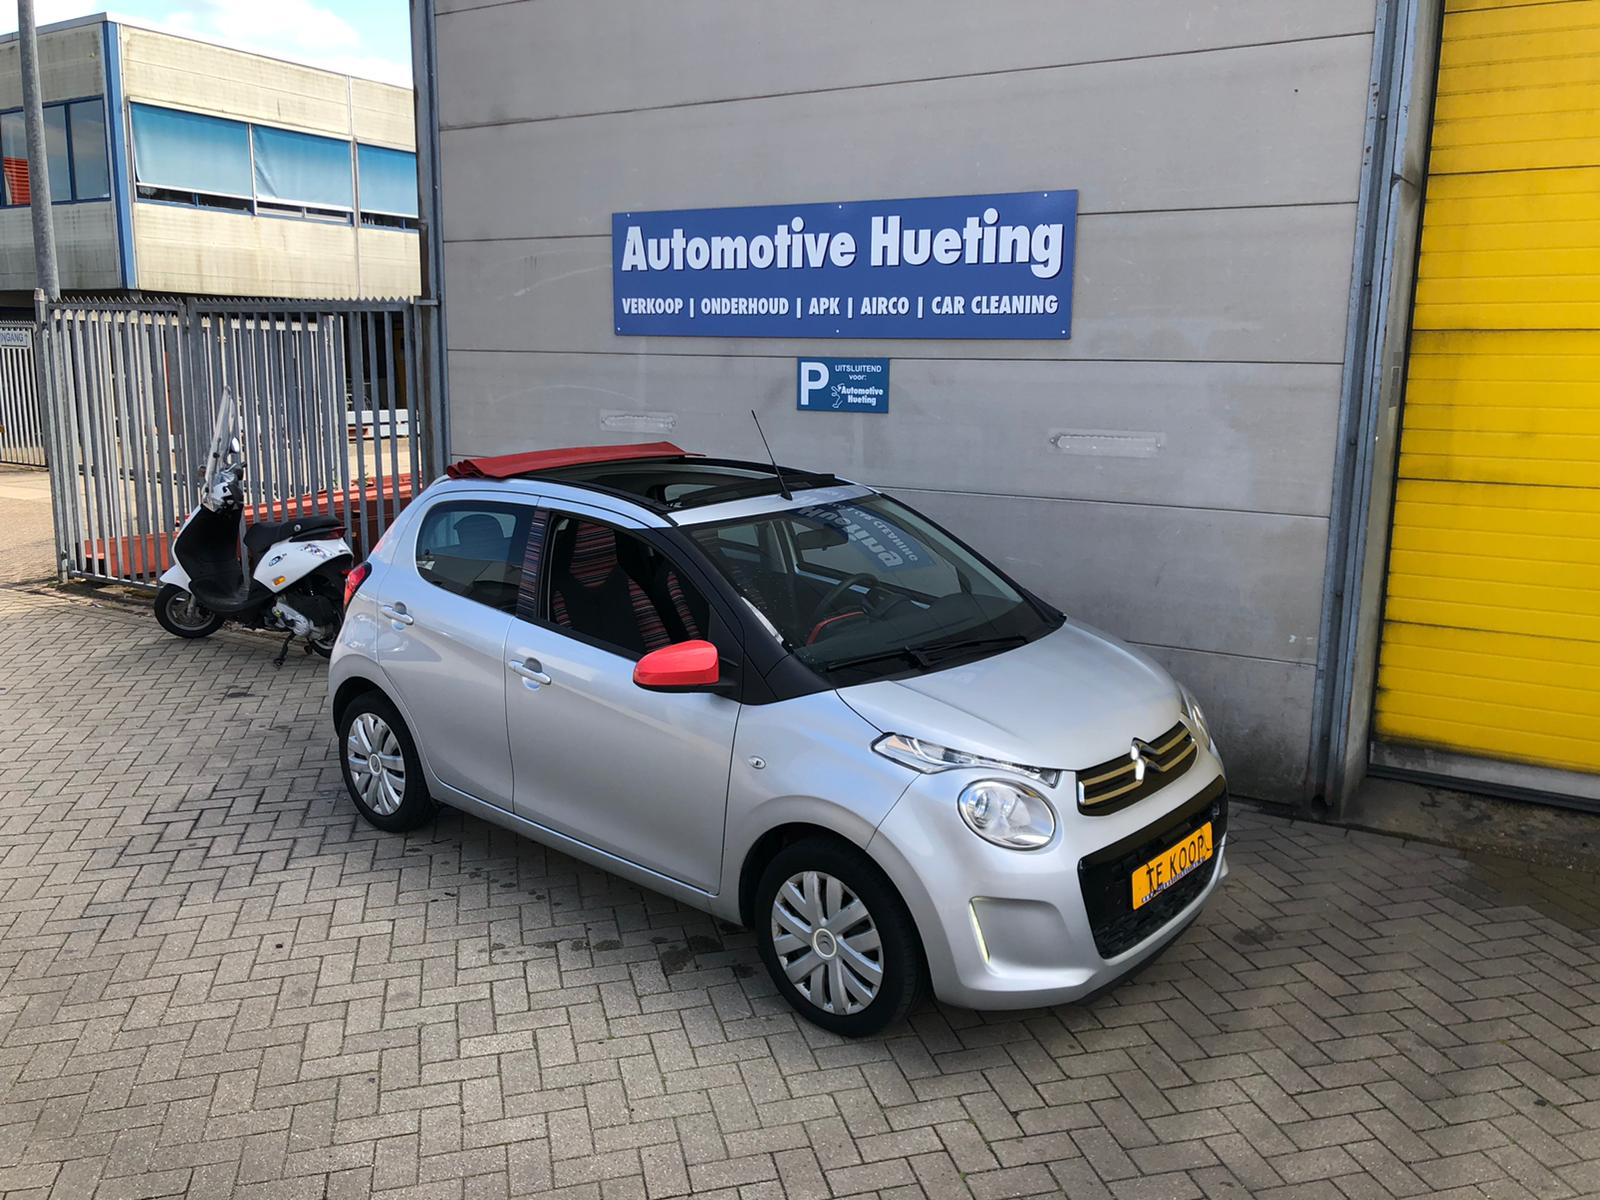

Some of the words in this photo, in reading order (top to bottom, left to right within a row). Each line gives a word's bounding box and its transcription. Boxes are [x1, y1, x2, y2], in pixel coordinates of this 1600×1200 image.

[621, 216, 857, 271] Automotive
[870, 207, 1064, 279] Hueting
[621, 296, 684, 316] VERKOOP
[700, 296, 790, 316] ONDERHOUD
[808, 296, 841, 316] APK
[860, 295, 911, 316] AIRCO
[931, 295, 966, 316] CAR
[971, 294, 1060, 316] CLEANING
[834, 364, 882, 373] UITSLUITEND
[800, 361, 830, 406] P
[841, 385, 884, 396] Automotive
[847, 395, 877, 406] Hueting
[1146, 860, 1164, 894] TE
